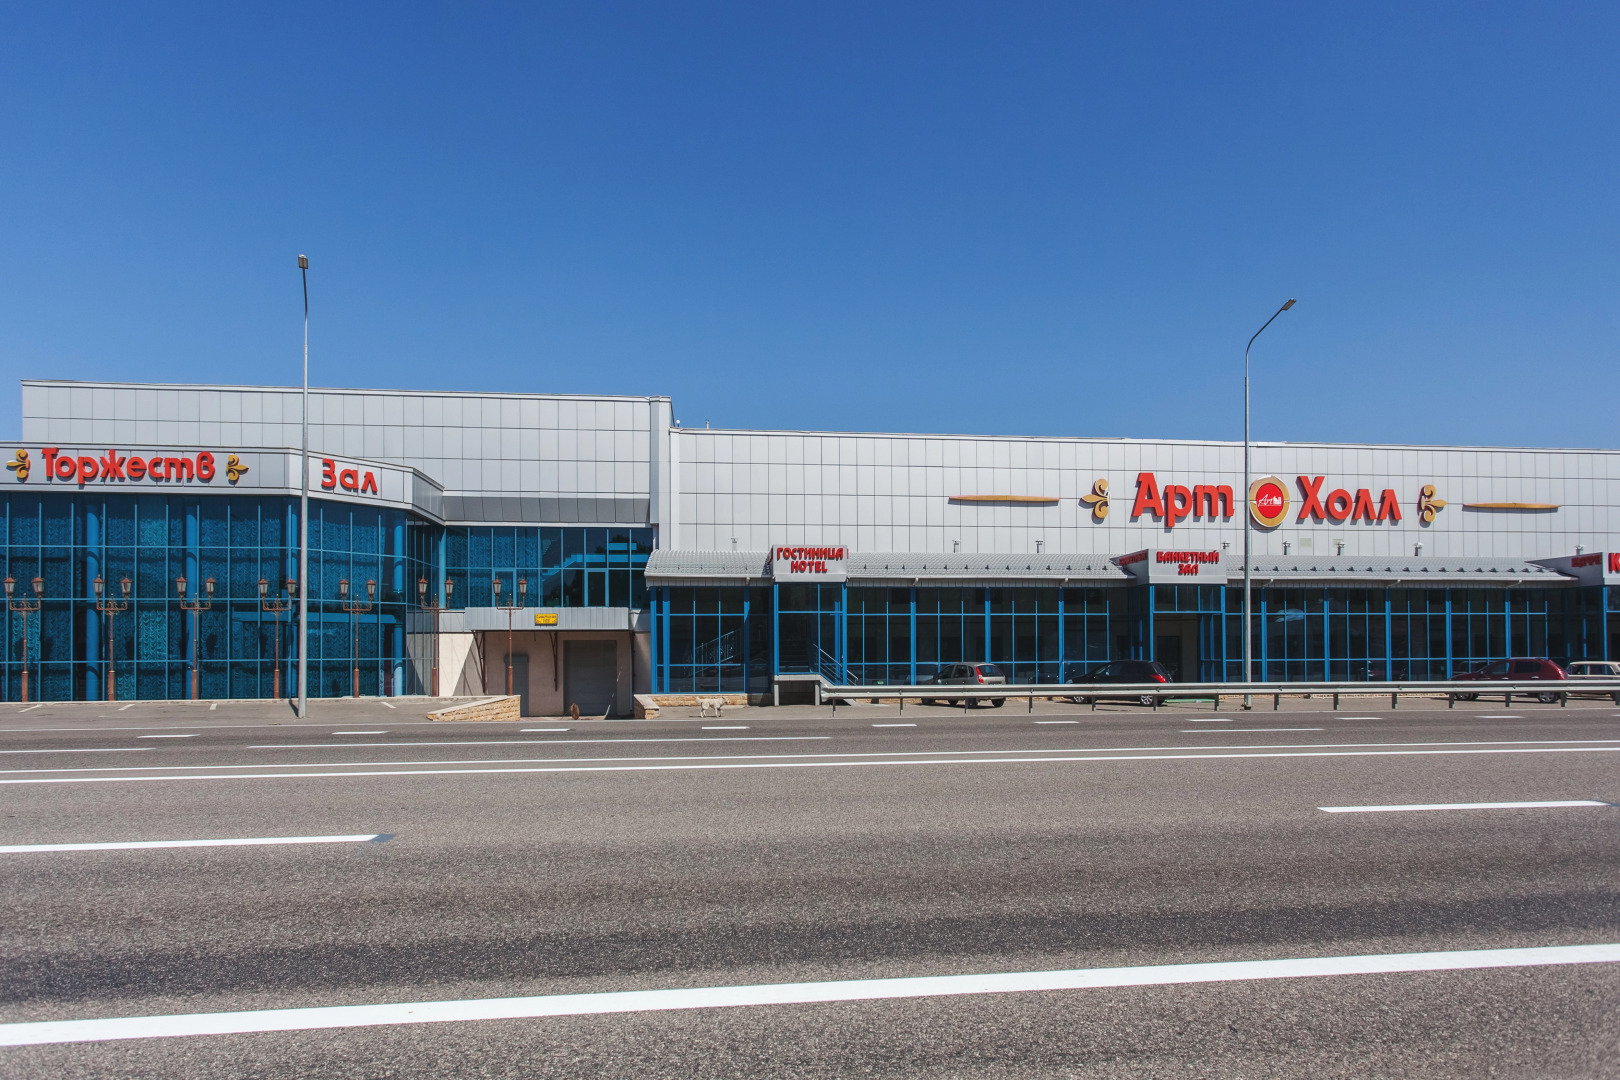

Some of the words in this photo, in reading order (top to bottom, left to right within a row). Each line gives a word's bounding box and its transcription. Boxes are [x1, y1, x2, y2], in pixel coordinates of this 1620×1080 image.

[41, 447, 215, 485] Торжеств
[321, 458, 378, 493] Зал
[1132, 472, 1235, 528] Арт
[1298, 475, 1403, 521] Холл
[776, 547, 844, 560] ГОСТИНИЦА
[1156, 549, 1220, 563] БАНКЕТНЫЙ
[791, 560, 828, 573] HOTEL
[1179, 563, 1199, 575] ЗАЛ
